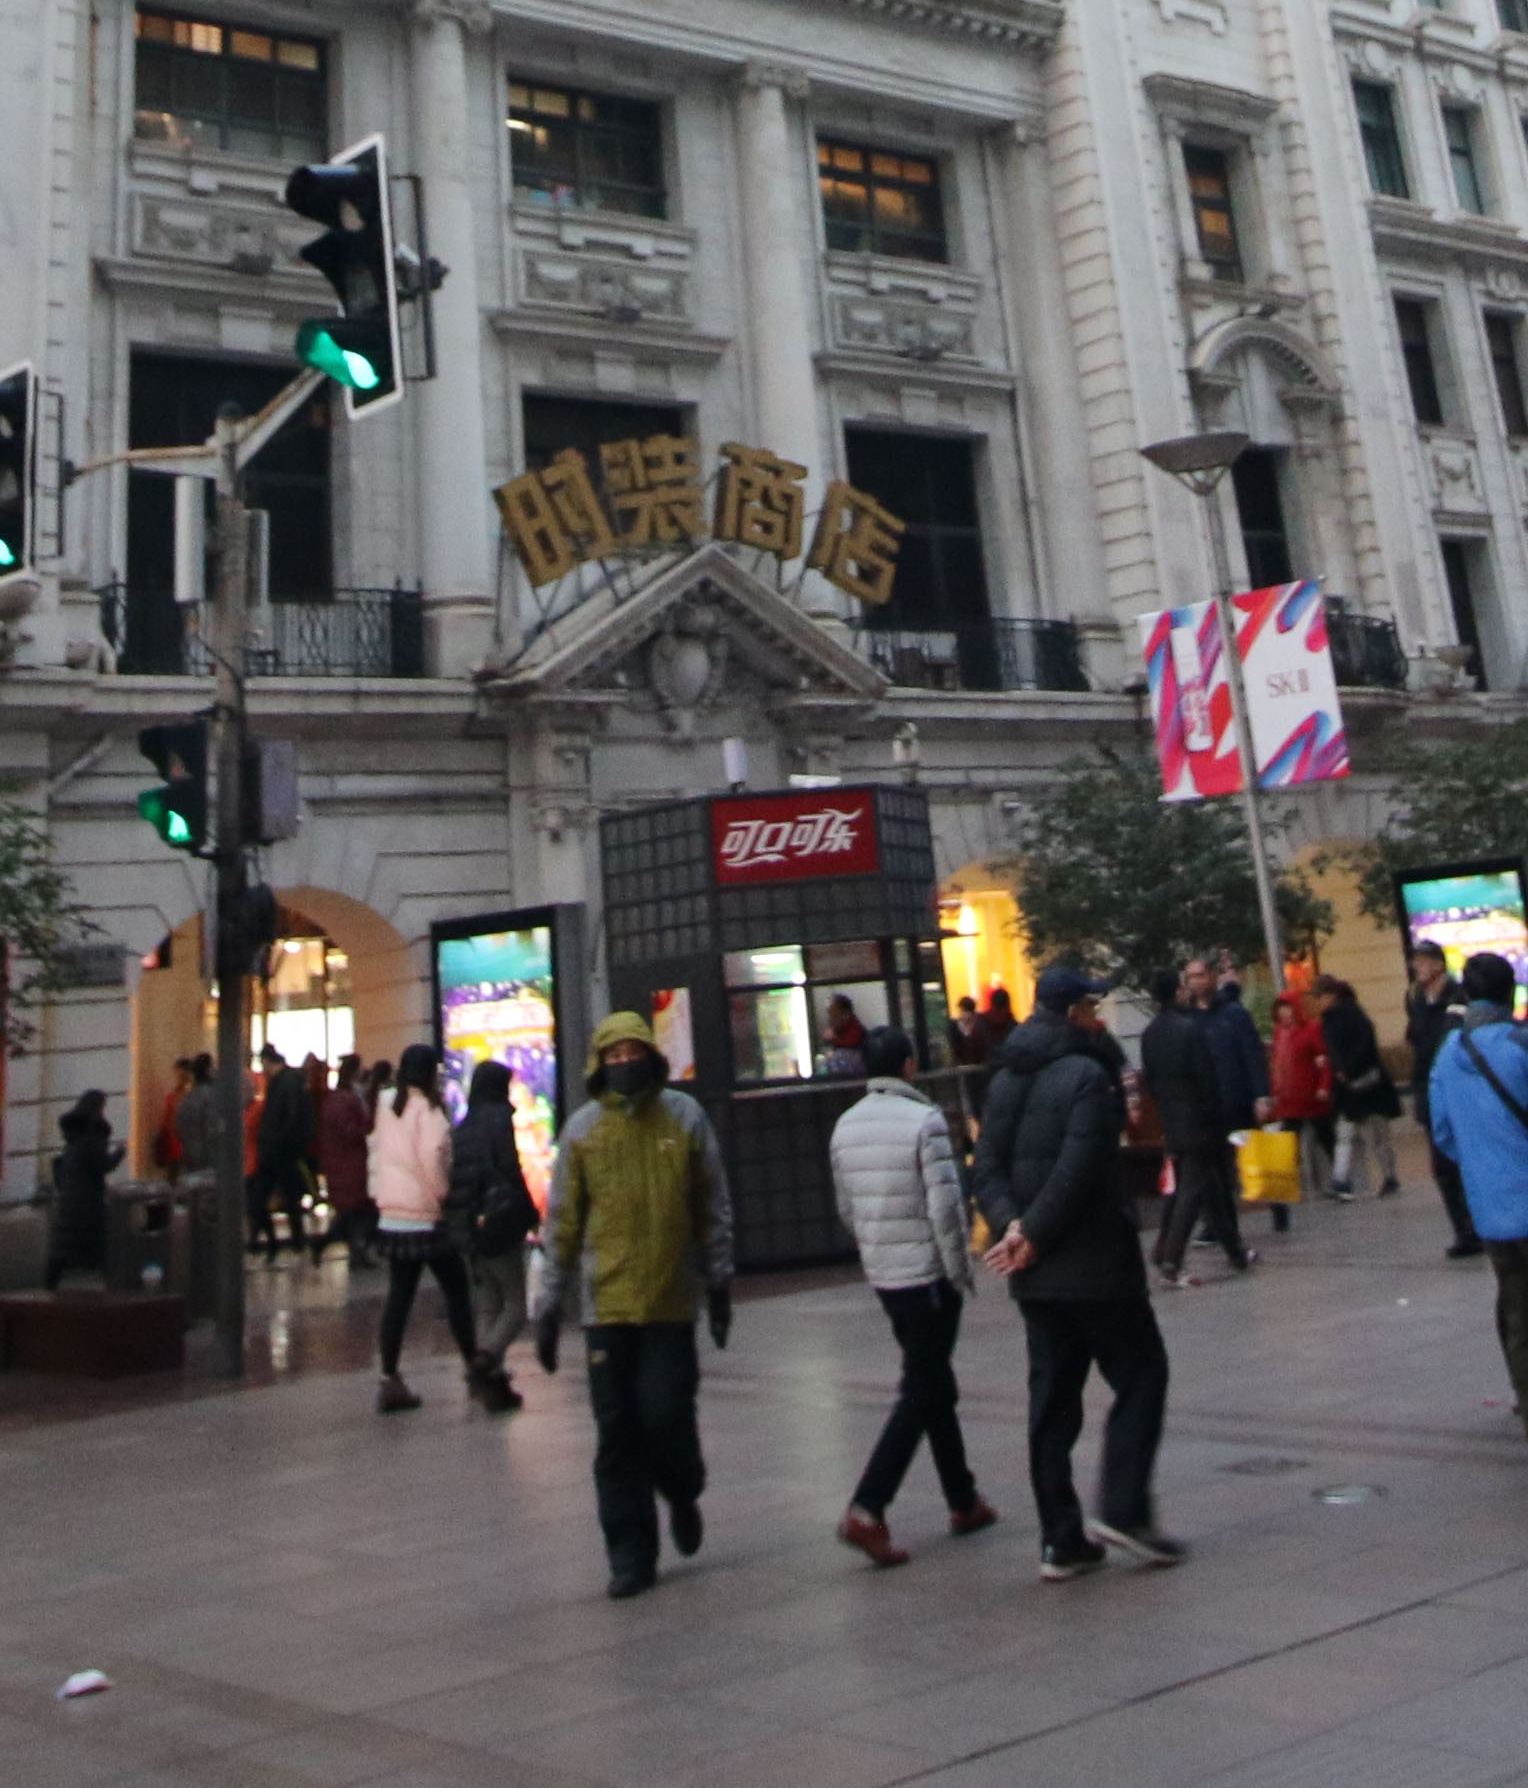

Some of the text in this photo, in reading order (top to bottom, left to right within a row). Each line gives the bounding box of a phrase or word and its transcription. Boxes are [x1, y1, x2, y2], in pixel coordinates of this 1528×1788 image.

[493, 433, 906, 605] 时装商店
[720, 808, 864, 868] 可口可乐
